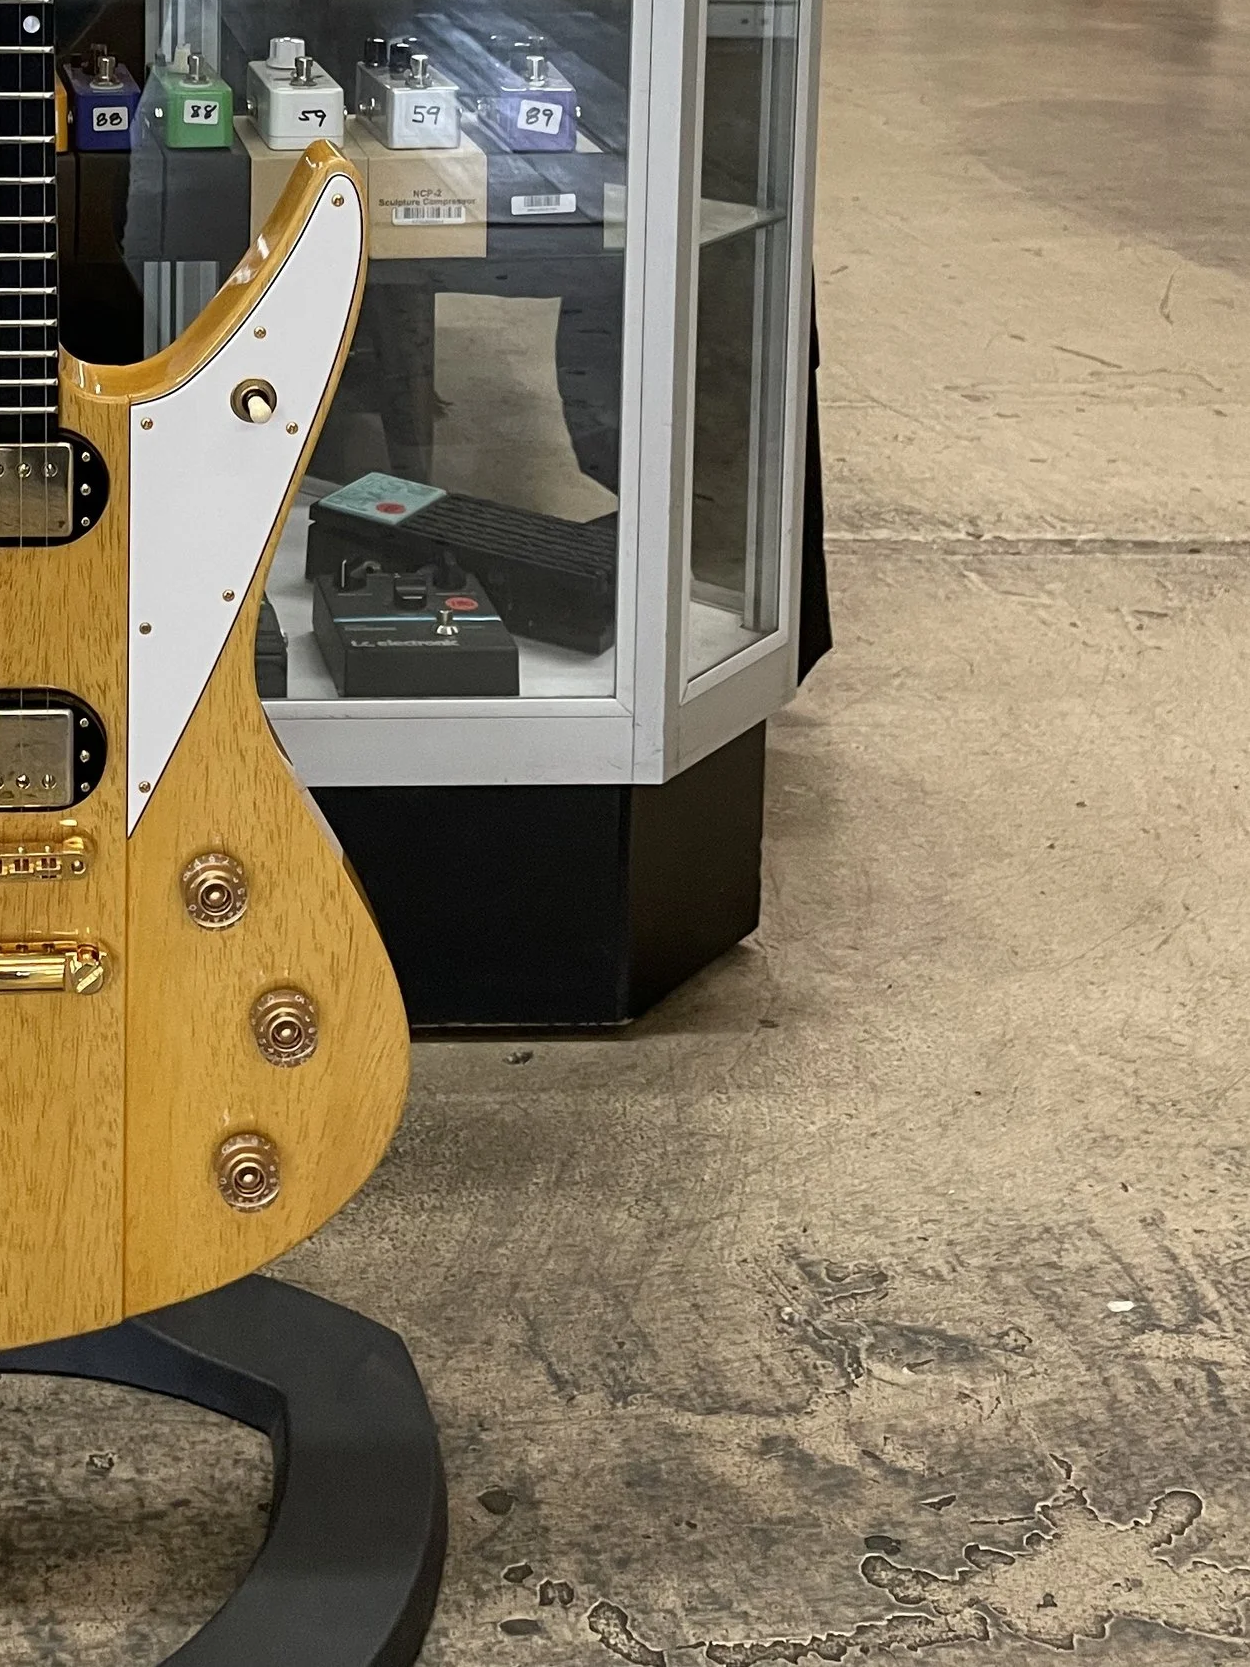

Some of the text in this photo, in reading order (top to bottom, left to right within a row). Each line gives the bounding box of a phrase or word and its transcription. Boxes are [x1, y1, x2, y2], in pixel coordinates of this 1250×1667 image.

[95, 112, 123, 127] 88
[190, 104, 218, 120] 88
[411, 105, 441, 126] 59
[525, 107, 555, 128] 89
